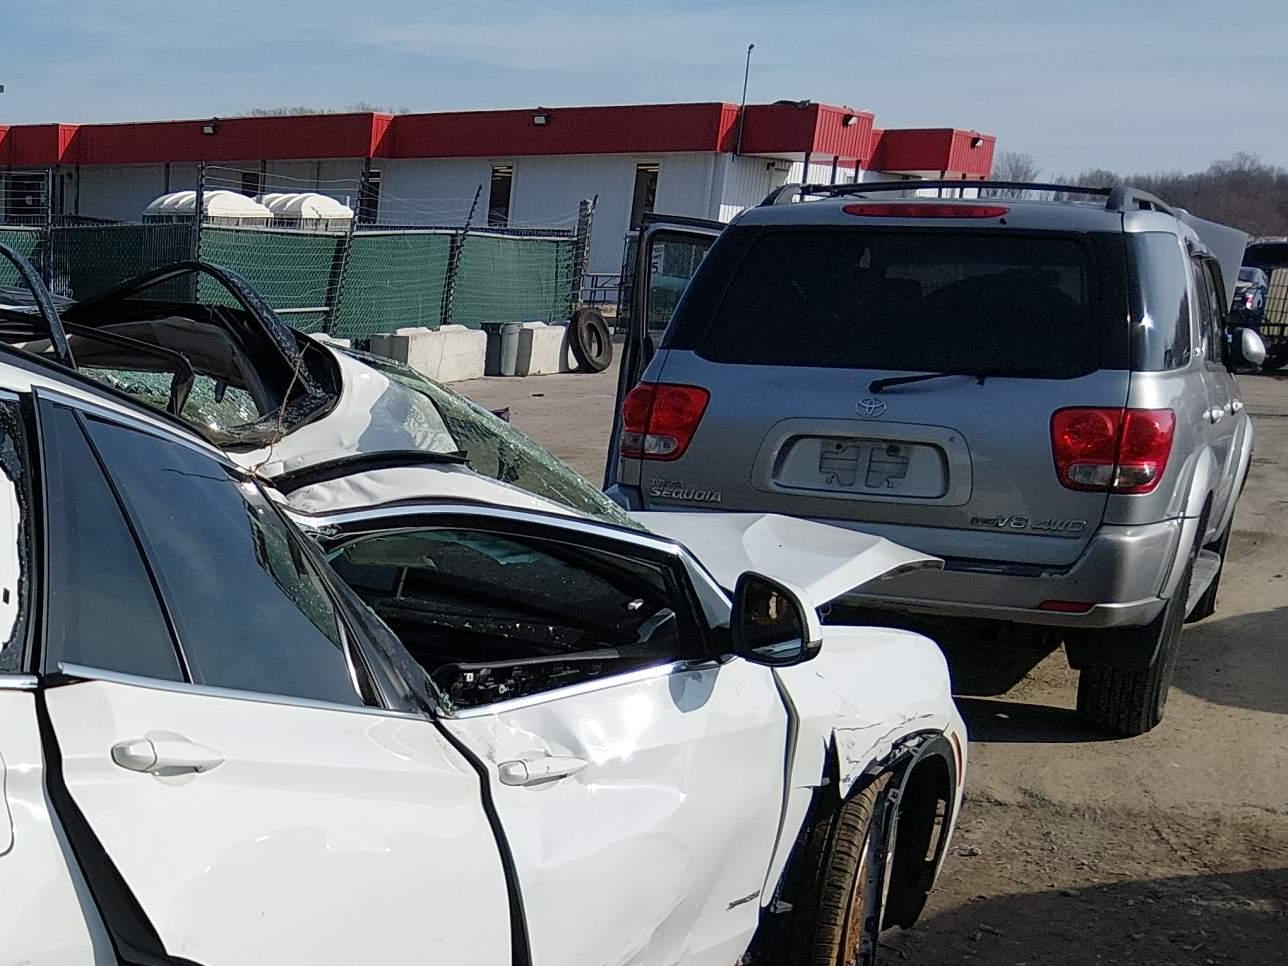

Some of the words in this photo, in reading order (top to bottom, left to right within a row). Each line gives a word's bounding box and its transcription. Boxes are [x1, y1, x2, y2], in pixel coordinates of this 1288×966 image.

[650, 486, 722, 503] SEQUOIA
[998, 513, 1030, 529] V8
[1031, 519, 1087, 532] 4WD
